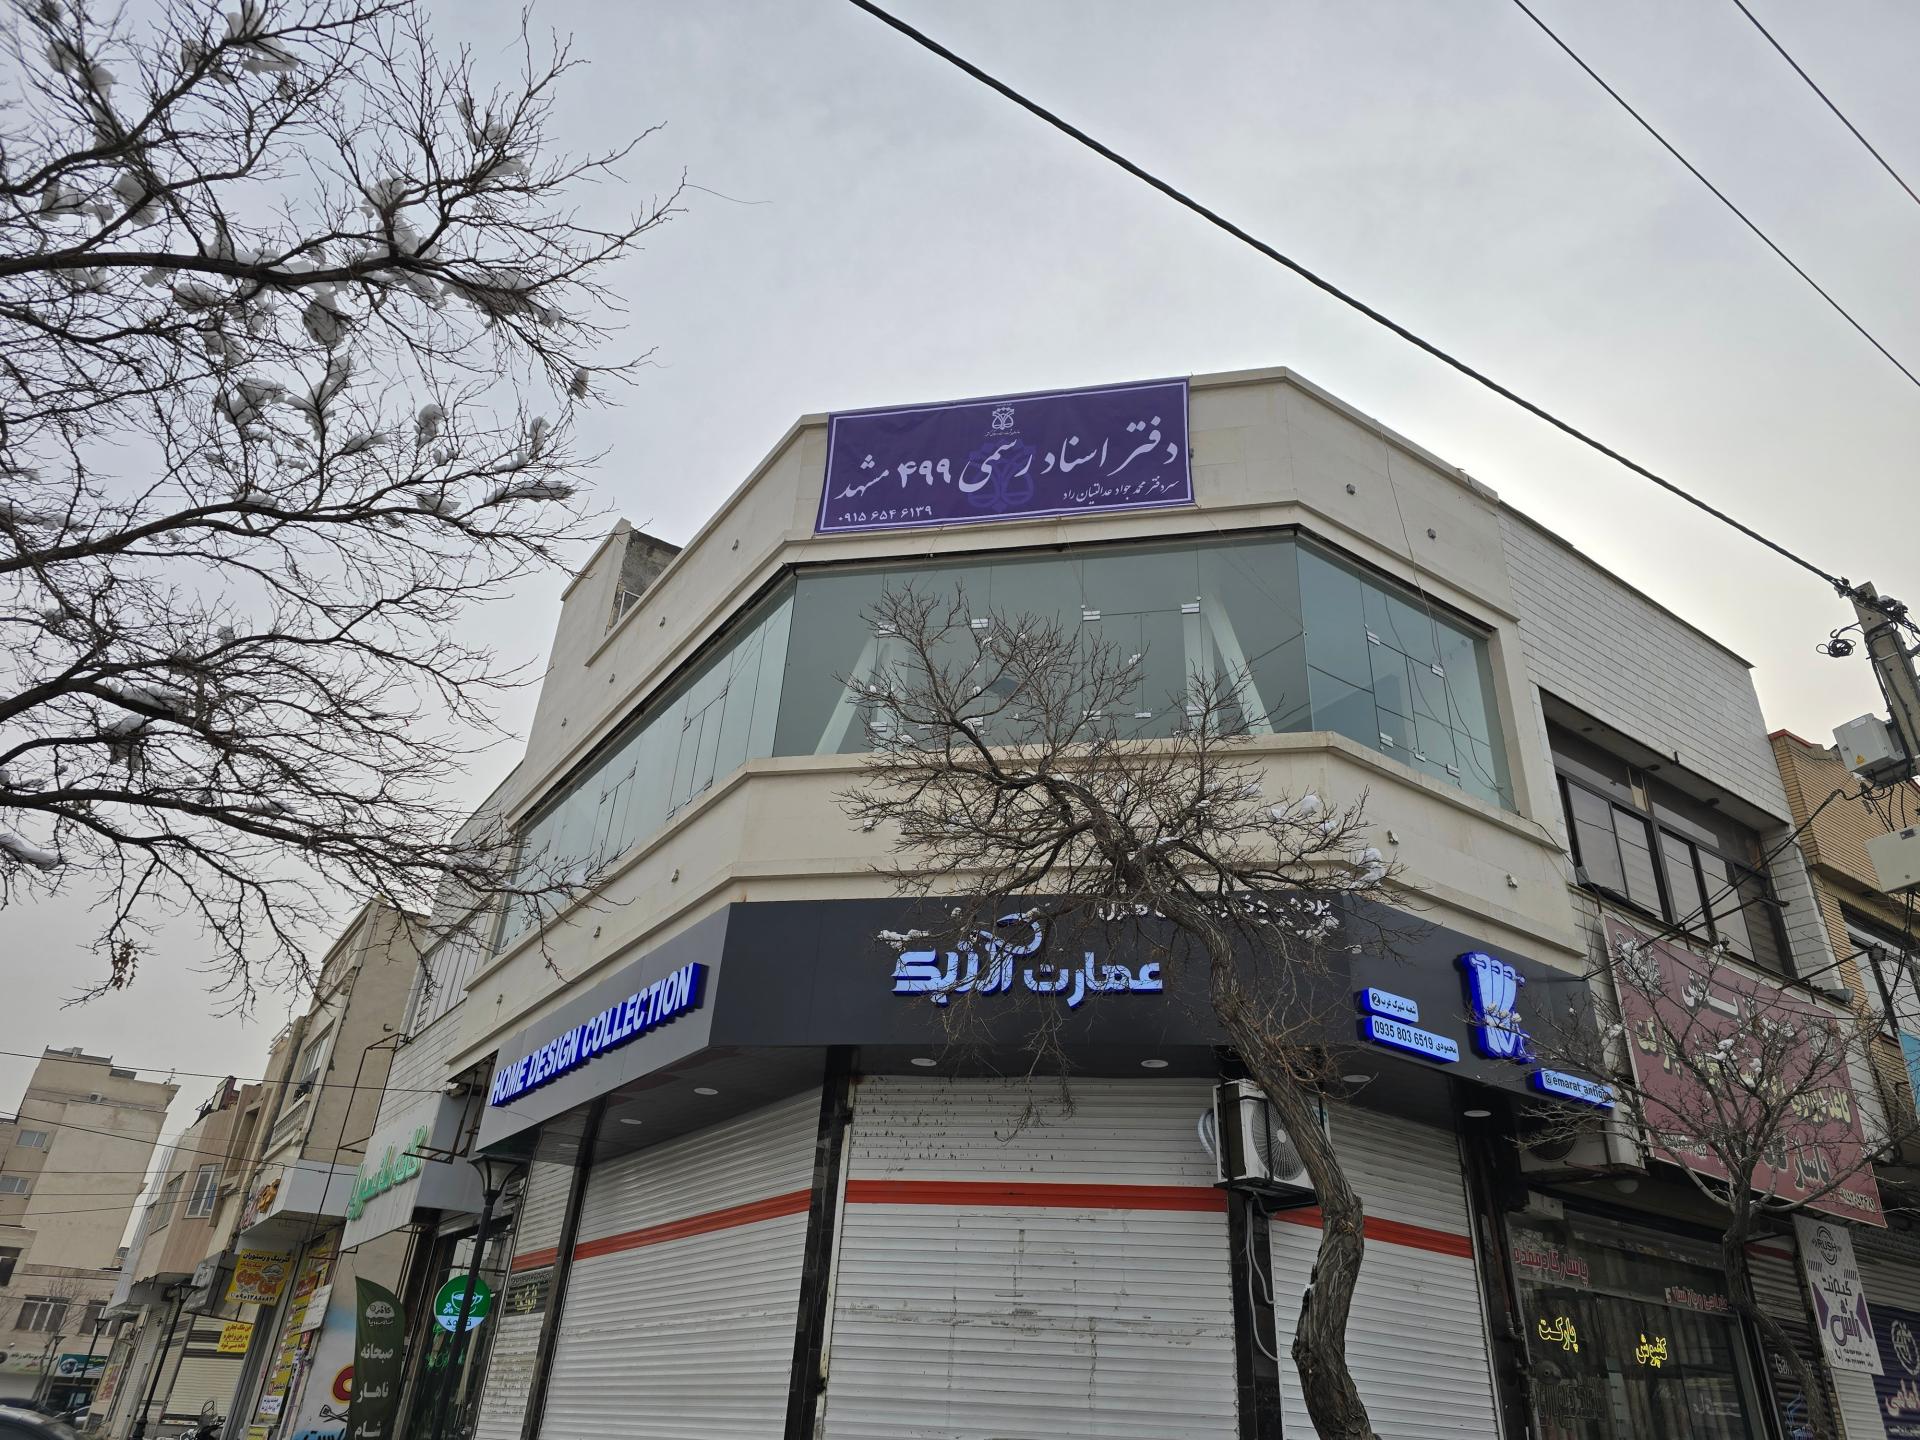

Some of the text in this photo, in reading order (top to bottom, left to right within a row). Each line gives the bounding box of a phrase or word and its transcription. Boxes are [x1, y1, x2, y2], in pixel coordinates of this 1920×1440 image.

[833, 415, 1178, 500] دفتر اسناد رسمی ۴۹۹ مشهد
[1063, 489, 1075, 501] راد
[1114, 484, 1131, 500] جواد
[1133, 481, 1146, 495] محمد
[837, 505, 933, 522] ۰۹۱۵ ۶۵۴ ۶۱۳۹
[1024, 951, 1164, 1010] عمارت
[491, 962, 700, 1106] HOME DESIGN COLLECTION
[1374, 1020, 1395, 1038] 0935
[1397, 1027, 1412, 1043] 803
[1414, 1032, 1434, 1050] 6519
[1816, 1239, 1837, 1252] RUSH
[1538, 1316, 1579, 1353] پارکت
[360, 1342, 394, 1365] صبحانه
[1636, 1333, 1668, 1369] کفپوش
[356, 1380, 389, 1403] ناهار
[354, 1420, 382, 1440] شام
